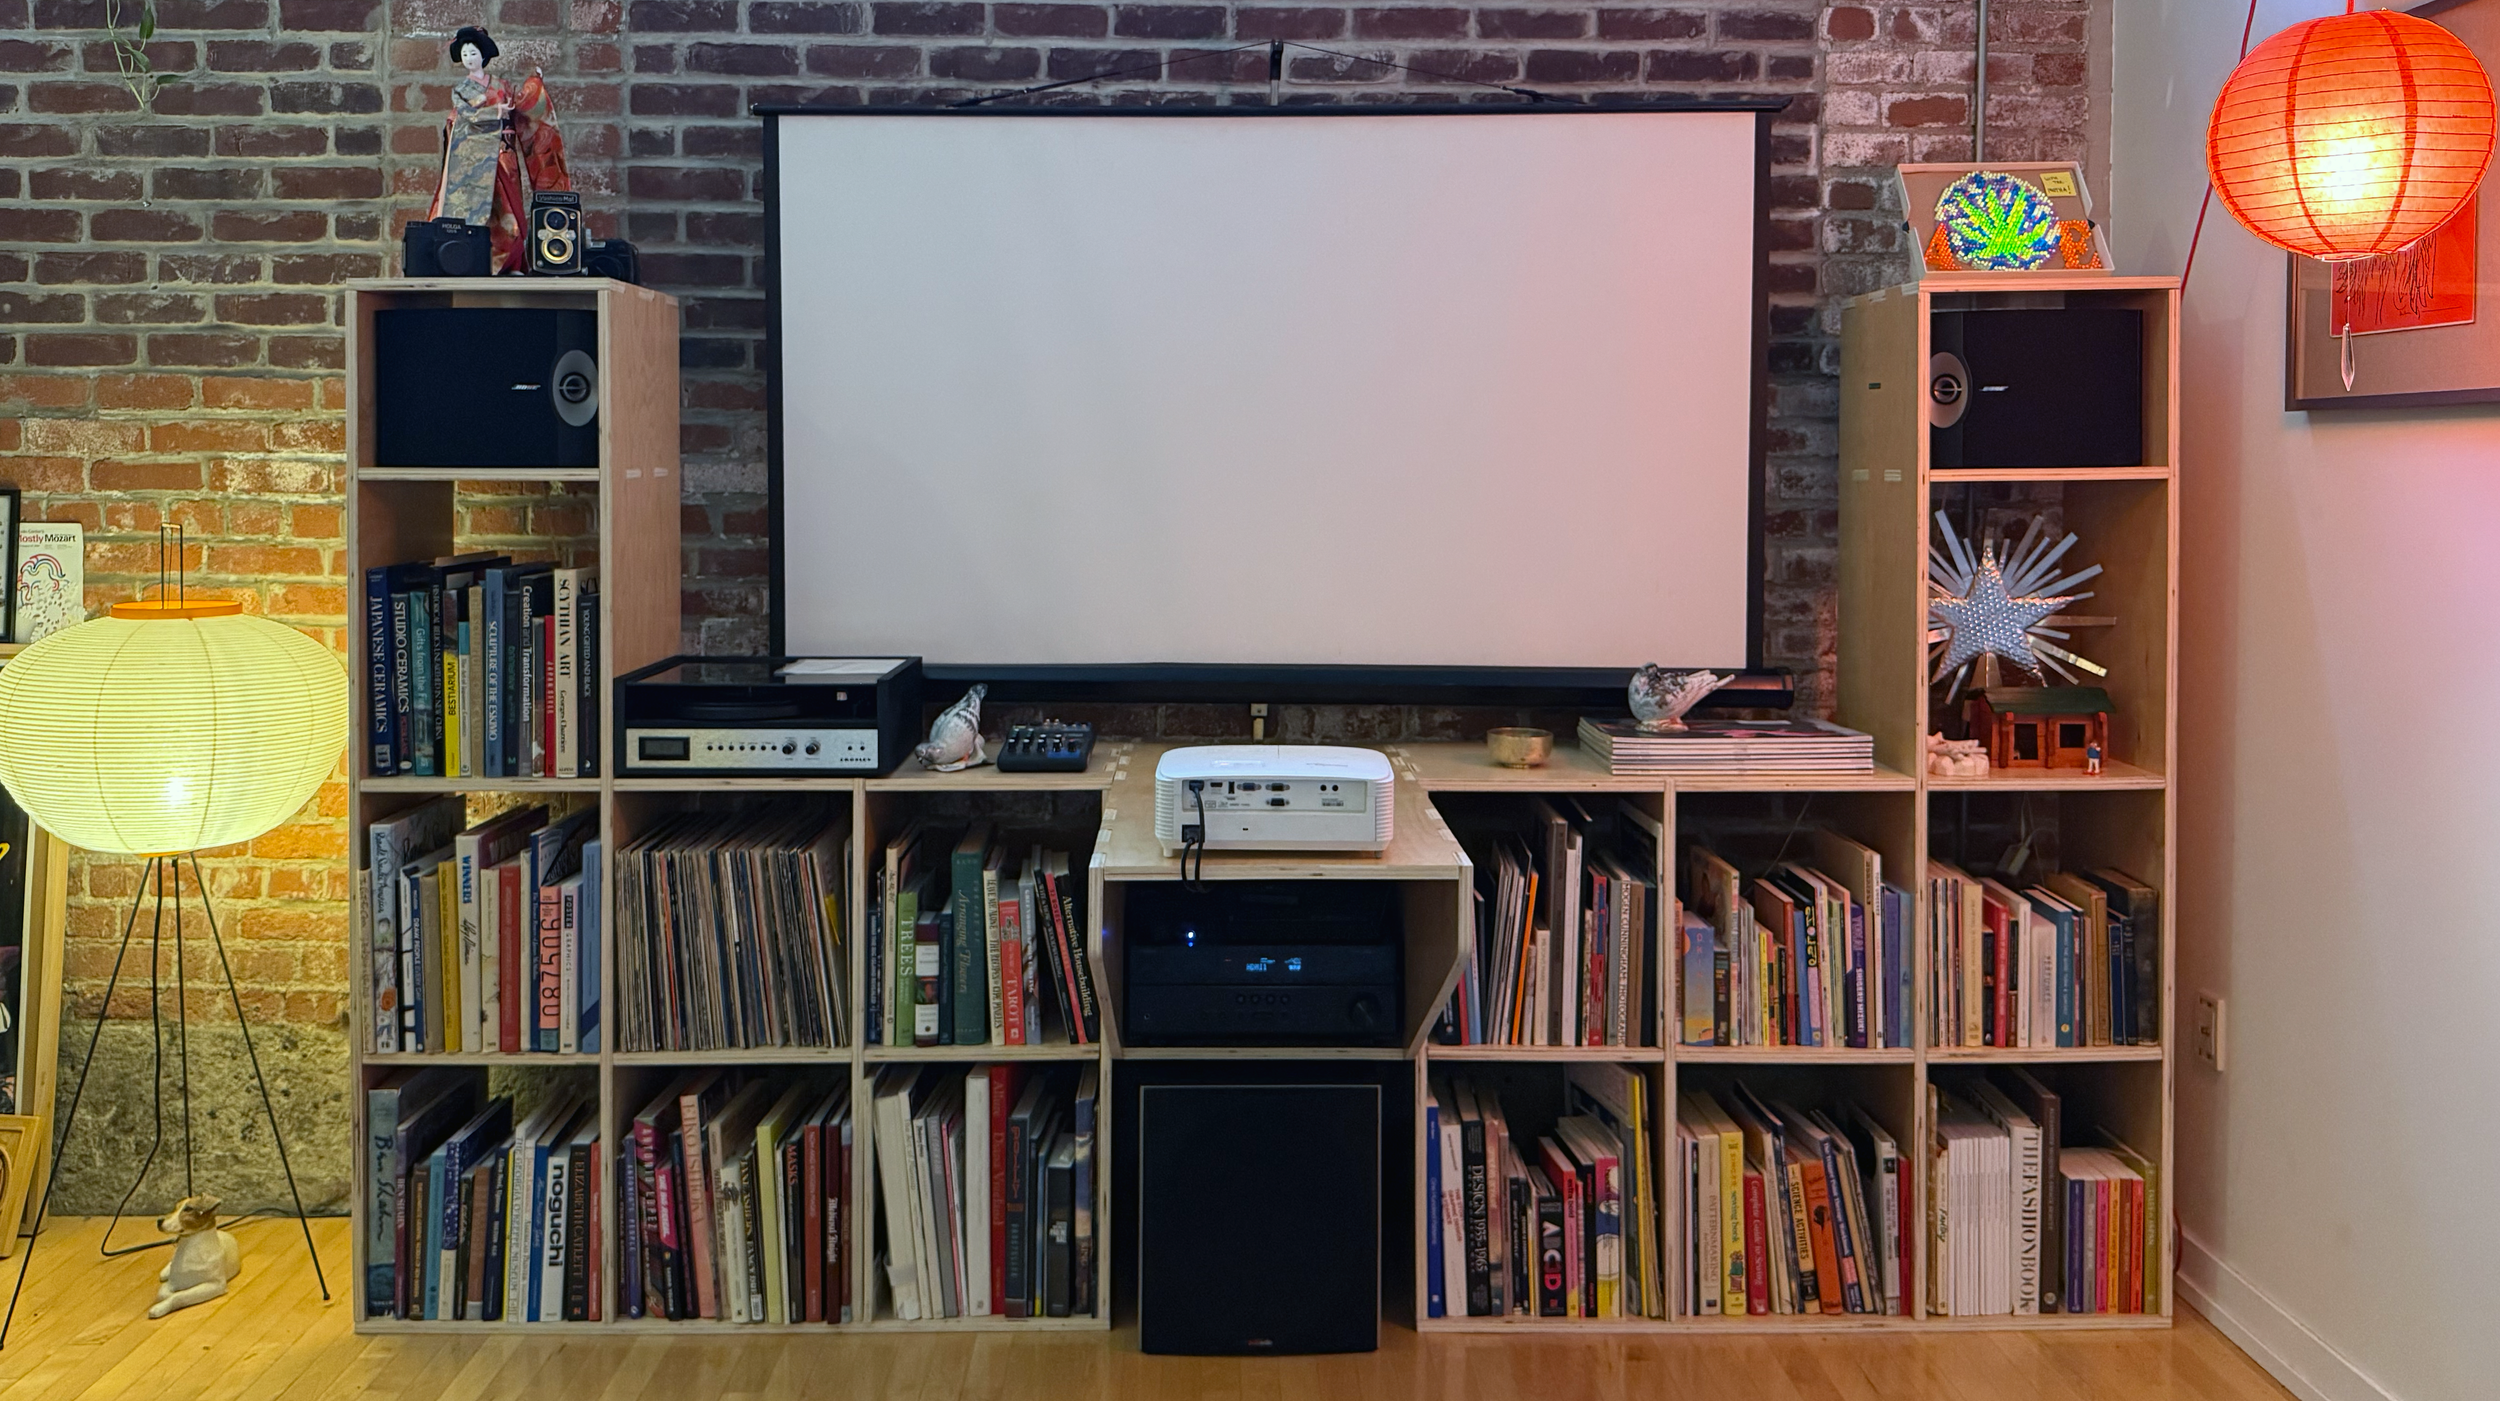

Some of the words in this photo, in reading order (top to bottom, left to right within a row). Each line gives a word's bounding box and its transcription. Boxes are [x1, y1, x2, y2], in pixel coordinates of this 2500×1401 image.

[44, 533, 77, 543] Mozart
[394, 601, 407, 647] STUDIO
[523, 586, 532, 627] Creation
[558, 578, 571, 647] SCYTHIAN
[369, 595, 385, 662] JAPANESE
[416, 628, 426, 650] Gifts
[489, 621, 498, 671] SCULPTURE
[523, 628, 532, 646] and
[583, 635, 591, 659] GIFTED
[396, 649, 409, 714] CERAMICS
[416, 652, 426, 675] from
[489, 673, 497, 685] OF
[559, 652, 571, 679] ART
[372, 663, 388, 733] CERAMICS
[417, 676, 427, 691] the
[446, 662, 456, 716] BESTIARIUM
[489, 686, 497, 703] THE
[523, 647, 533, 722] Transformation
[583, 676, 591, 698] BLACK
[434, 717, 443, 741] CHINA
[489, 704, 497, 741] ESKIMO
[462, 855, 472, 903] WINNERS
[956, 890, 971, 947] Arranging
[1062, 895, 1082, 947] Alternative
[900, 917, 915, 977] TREES
[1618, 918, 1629, 981] CUNNINGHAM
[957, 950, 972, 994] Flowers
[1069, 947, 1093, 1017] Housebuilding
[1855, 967, 1864, 1003] SHIGERU
[1006, 979, 1020, 1025] TAROT
[993, 1081, 1005, 1117] Allure
[682, 1104, 698, 1147] EIKO
[374, 1134, 394, 1172] Ben
[515, 1138, 524, 1153] THE
[642, 1128, 654, 1183] ANTONIO
[993, 1132, 1005, 1168] Diana
[514, 1157, 523, 1201] GEORGIA
[714, 1169, 723, 1193] WHAT
[787, 1144, 798, 1186] MASKS
[397, 1178, 406, 1197] BEN
[574, 1161, 586, 1225] ELIZABETH
[686, 1153, 704, 1224] ISHIOKA
[1472, 1165, 1485, 1214] DESIGN
[1730, 1191, 1739, 1220] sewing
[1749, 1180, 1762, 1218] Complete
[1790, 1181, 1803, 1214] SCIENCE
[377, 1178, 396, 1242] Shahn
[397, 1199, 405, 1230] SHAHN
[548, 1164, 565, 1268] noguchi
[645, 1191, 657, 1230] LOPEZ
[716, 1198, 726, 1229] PEOPLE
[827, 1197, 839, 1233] Medieval
[1453, 1215, 1462, 1242] DESIGN
[1938, 1208, 1948, 1243] Fantasy
[719, 1232, 728, 1257] WORE
[827, 1234, 839, 1263] Knight
[1473, 1218, 1487, 1271] 1935-1965
[1708, 1194, 1719, 1282] PATTERNMAKING
[1732, 1221, 1740, 1243] book
[1753, 1219, 1763, 1243] Guide
[1754, 1246, 1763, 1254] to
[1795, 1217, 1809, 1260] ACTIVITIES
[572, 1225, 584, 1279] CATLETT
[1542, 1220, 1562, 1291] ABC3D
[511, 1251, 519, 1292] MUSEUM
[1754, 1257, 1765, 1286] Sewing
